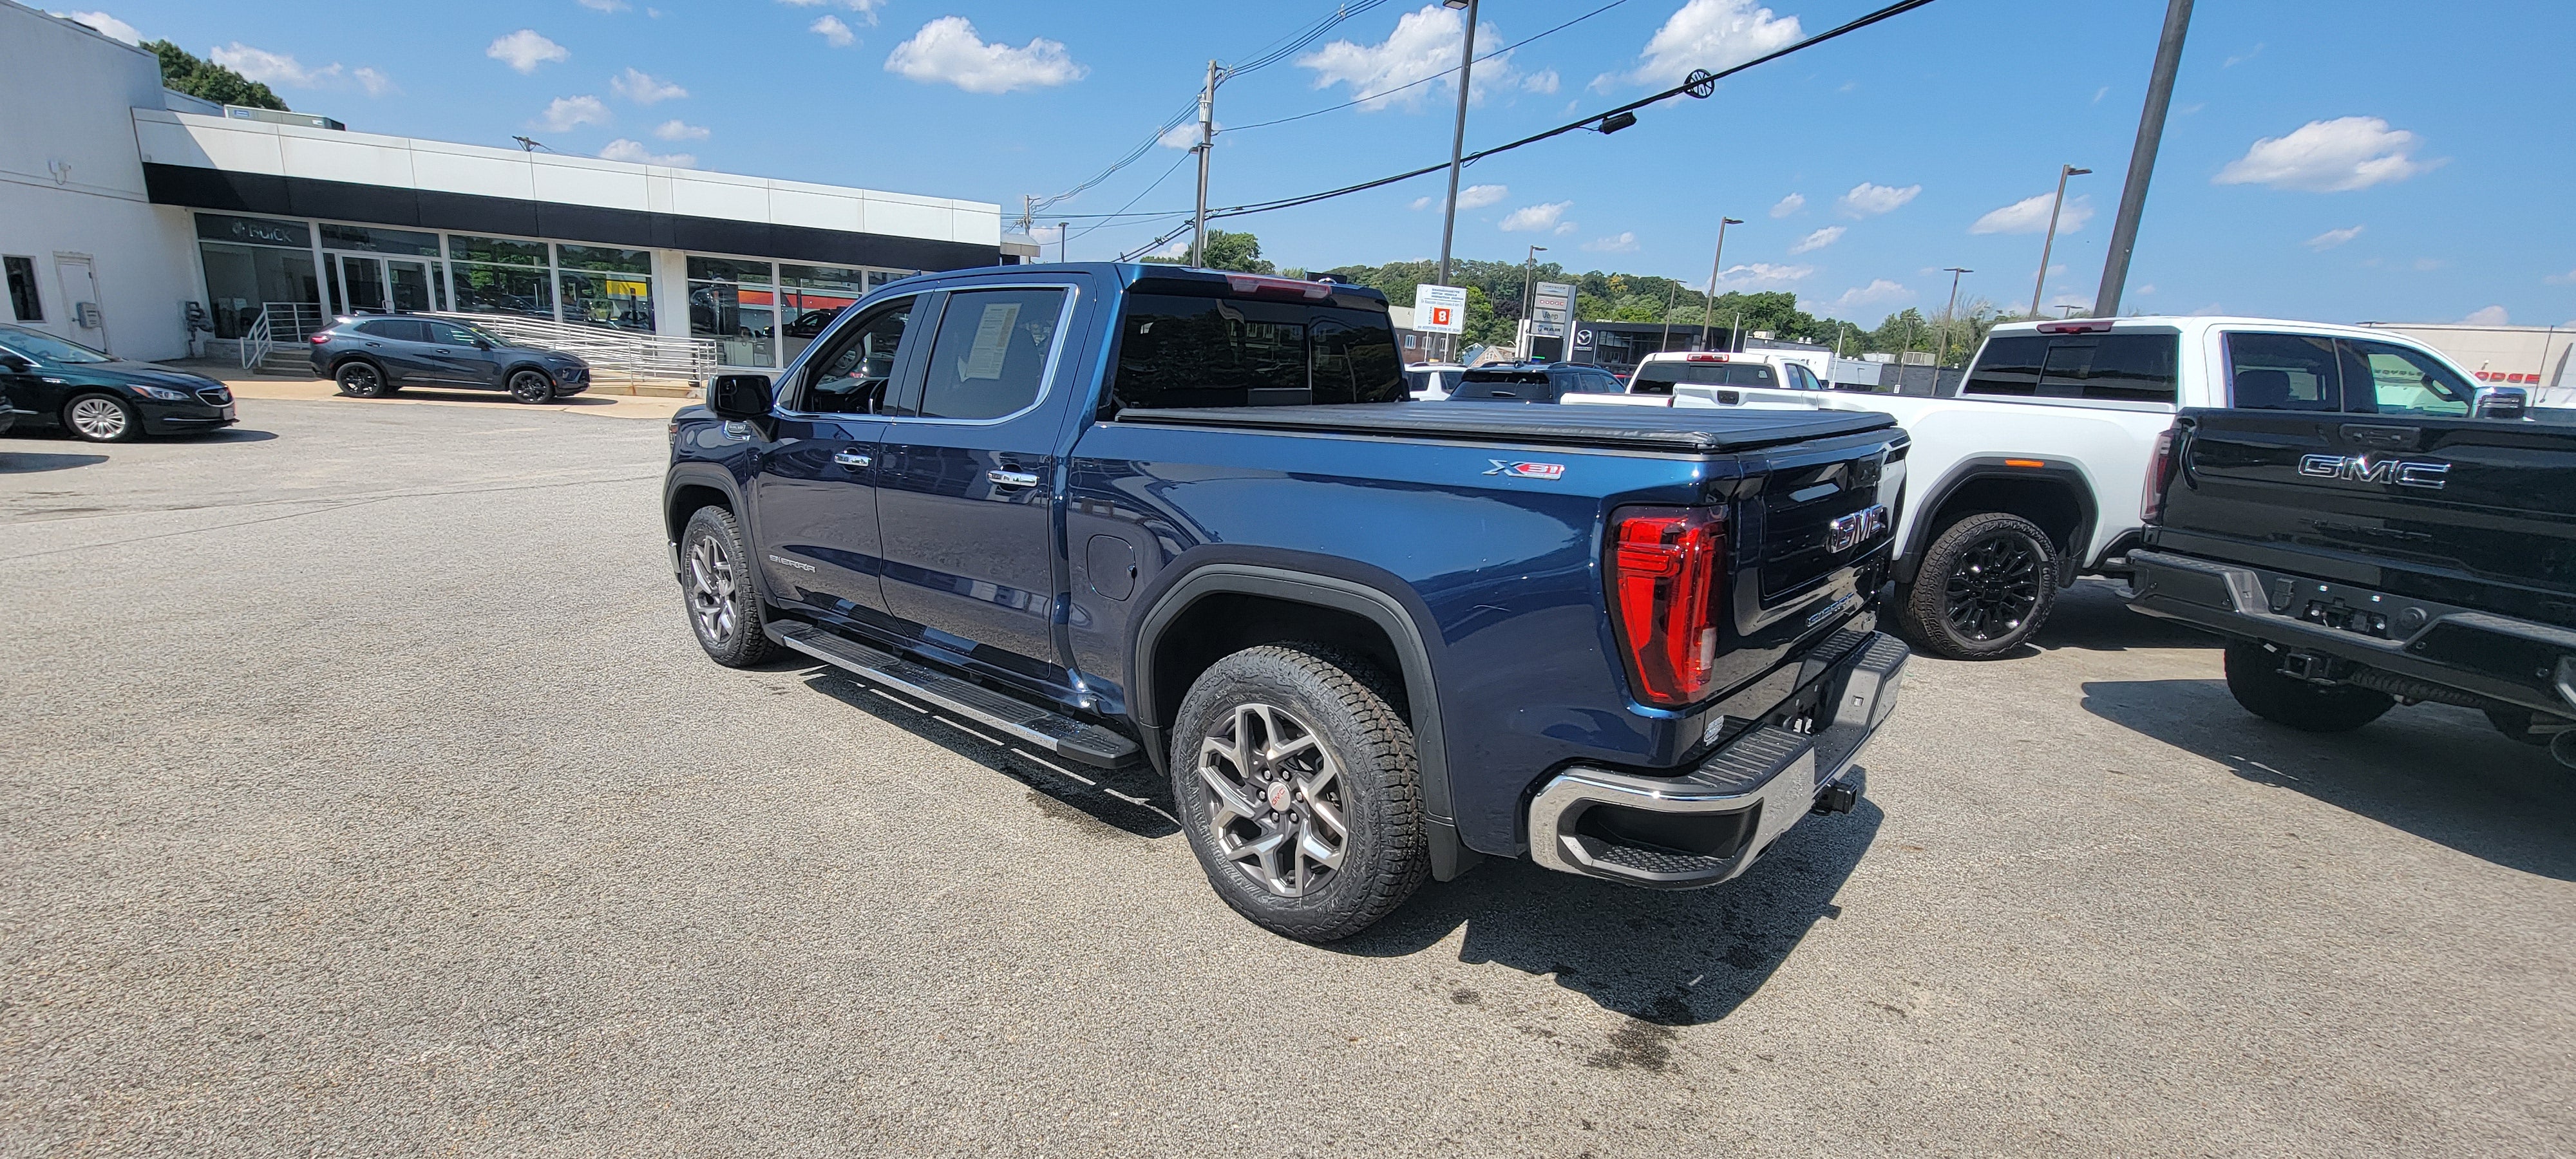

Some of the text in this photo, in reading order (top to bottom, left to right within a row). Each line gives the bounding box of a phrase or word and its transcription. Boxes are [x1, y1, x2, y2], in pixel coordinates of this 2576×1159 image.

[249, 225, 293, 242] BUICK
[1439, 310, 1447, 322] 8
[1542, 312, 1558, 320] Jeep
[2474, 372, 2540, 384] ODGE
[1482, 458, 1565, 479] X31
[2298, 453, 2452, 489] GMC
[1826, 503, 1887, 553] GMC
[769, 554, 816, 573] SIERRA
[1271, 787, 1285, 806] GMC
